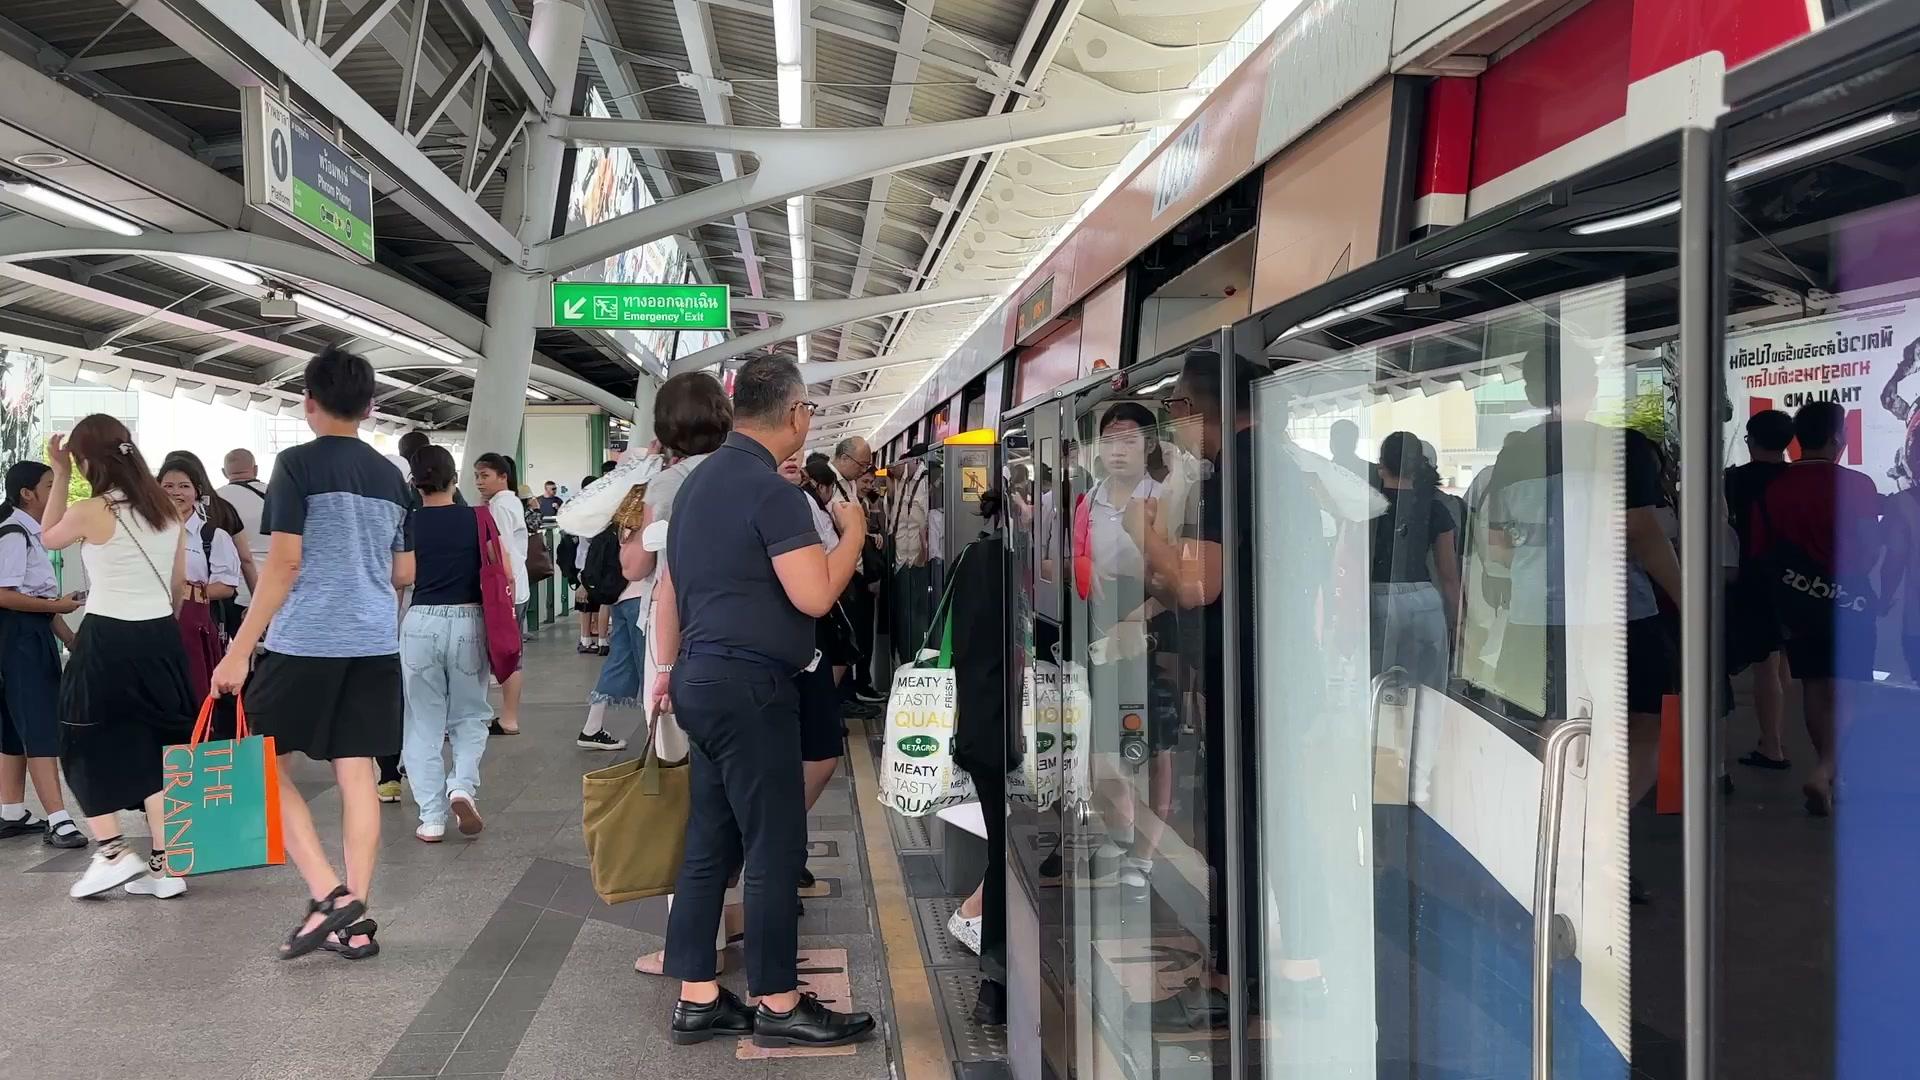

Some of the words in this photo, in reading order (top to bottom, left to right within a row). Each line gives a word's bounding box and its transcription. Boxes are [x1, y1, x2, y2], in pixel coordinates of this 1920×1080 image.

[273, 131, 284, 175] 1
[271, 185, 292, 205] Platform
[317, 173, 335, 197] Phrom
[335, 185, 352, 212] Phong
[623, 292, 719, 313] ทางออกฉุกเฉิน
[624, 312, 679, 323] Emergency
[685, 312, 705, 322] Exit
[897, 676, 941, 688] MEATY
[895, 692, 941, 706] TASTY
[945, 678, 953, 709] FRESH
[901, 743, 937, 752] BETAGRO
[203, 739, 233, 809] THE
[894, 761, 938, 777] MEATY
[895, 777, 937, 795] TASTY
[163, 745, 195, 877] GRAND
